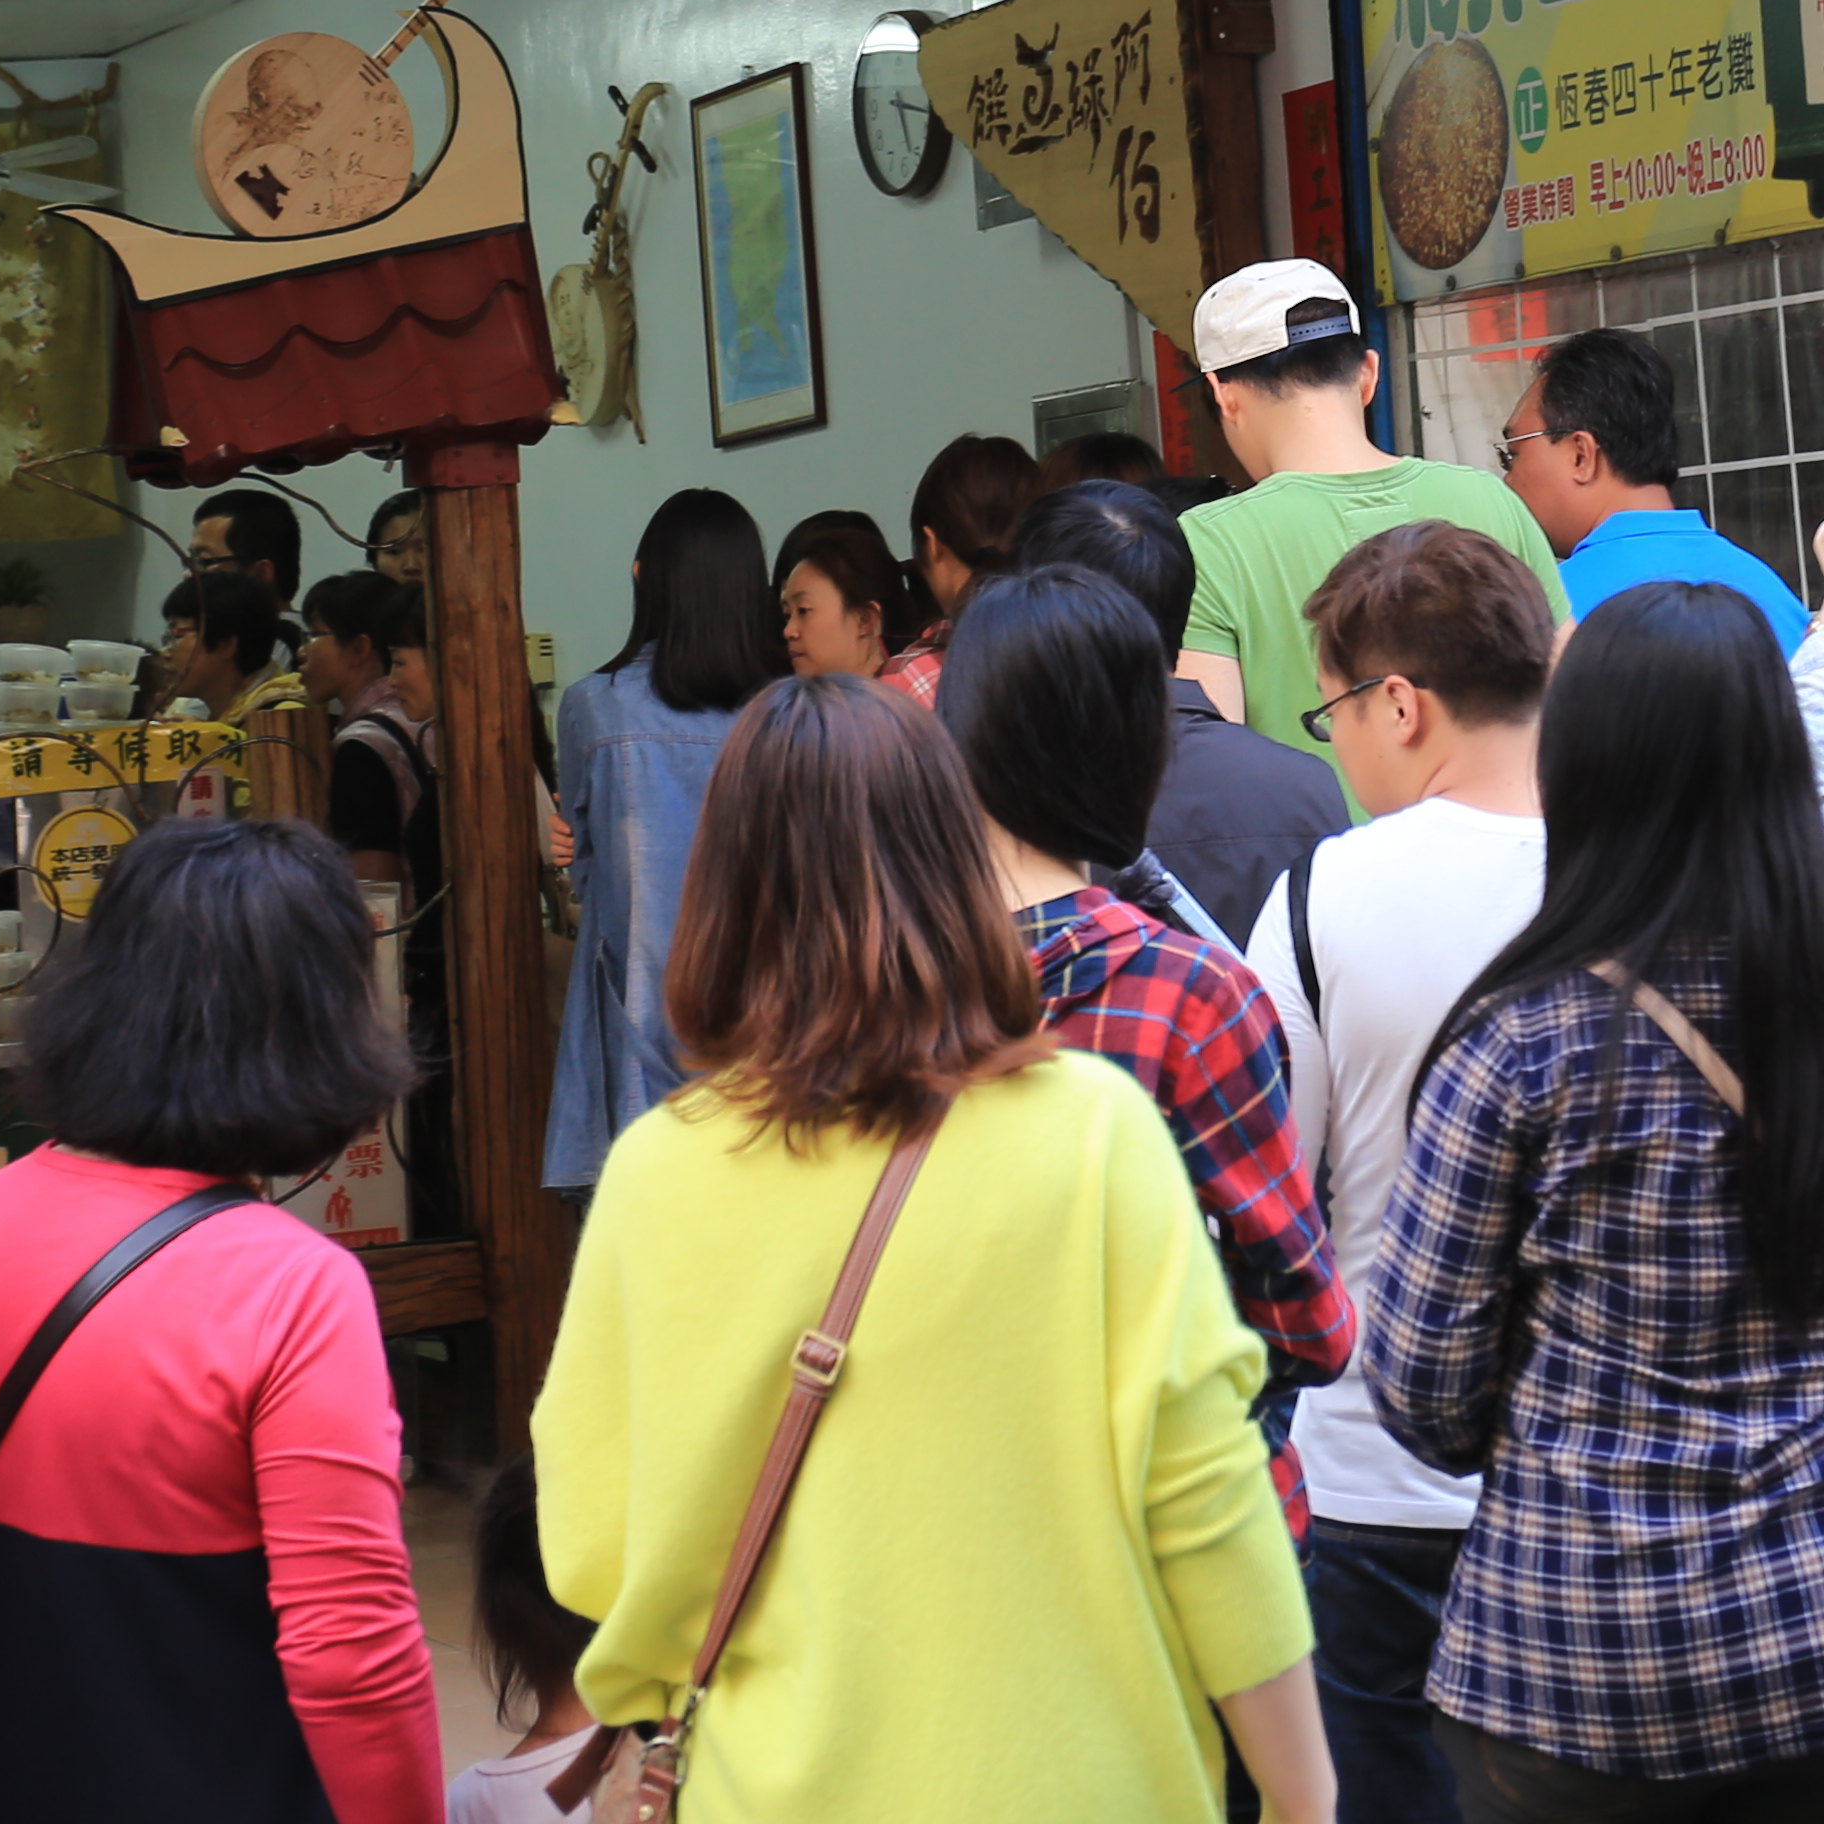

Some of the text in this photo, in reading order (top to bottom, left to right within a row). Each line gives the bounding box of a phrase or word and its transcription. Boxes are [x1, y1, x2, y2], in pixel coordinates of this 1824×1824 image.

[1516, 32, 1756, 143] 正 恆春四十年老攤
[1502, 176, 1576, 230] 營業時間
